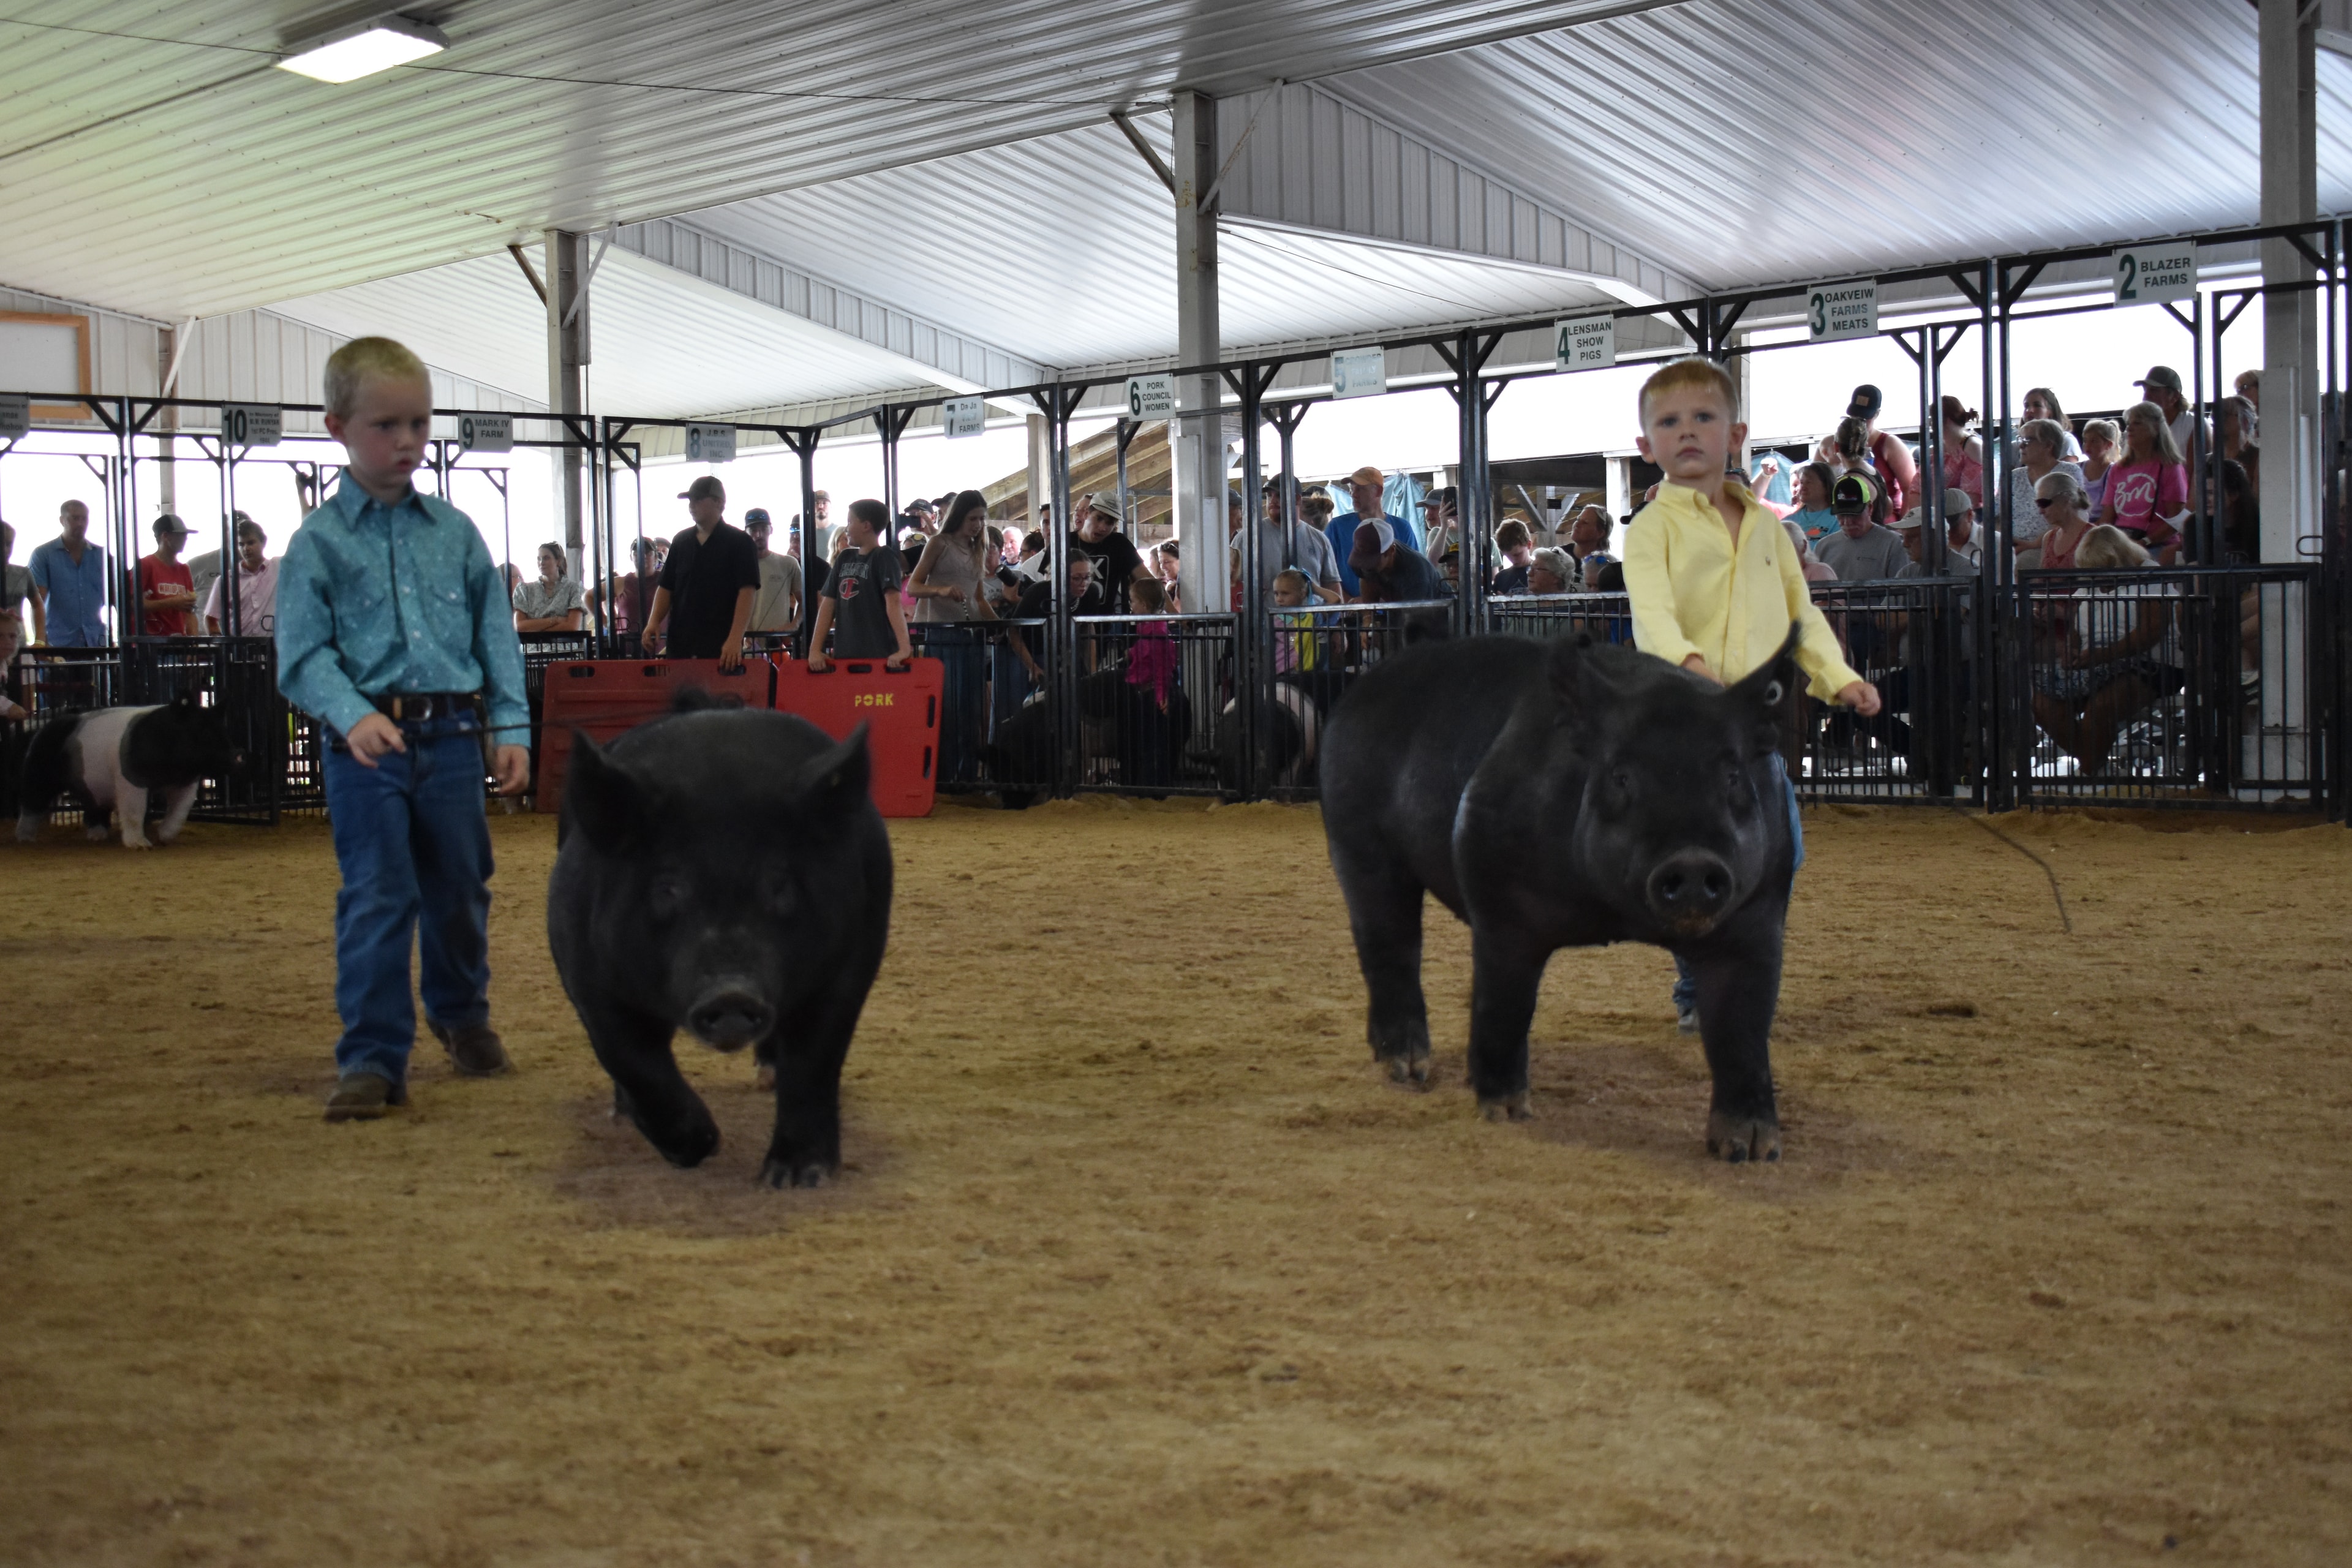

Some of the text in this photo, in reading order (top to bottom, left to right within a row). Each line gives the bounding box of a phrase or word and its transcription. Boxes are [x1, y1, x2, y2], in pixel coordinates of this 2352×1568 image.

[2140, 257, 2191, 272] BLAZER
[2119, 254, 2136, 300] 2
[2144, 273, 2188, 288] FARMS
[1825, 288, 1874, 303] OAKVEIW
[1810, 293, 1825, 336] 3
[1831, 303, 1868, 317] FARMS
[1568, 321, 1612, 336] LENSMAN
[1832, 318, 1869, 331] MEATS
[1557, 326, 1570, 365] 4
[1577, 336, 1604, 349] SHOW
[1580, 350, 1602, 361] PIGS
[1334, 356, 1346, 393] 5
[1147, 381, 1165, 390] PORK
[1130, 381, 1141, 417] 6
[1142, 391, 1172, 402] COUNCIL
[1144, 402, 1170, 412] WOMEN
[224, 409, 247, 443] 10
[475, 419, 499, 428] MARK
[946, 404, 956, 436] 7
[462, 418, 474, 450] 9
[959, 423, 981, 434] FARMS
[690, 428, 701, 459] 8
[854, 693, 894, 707] PORK
